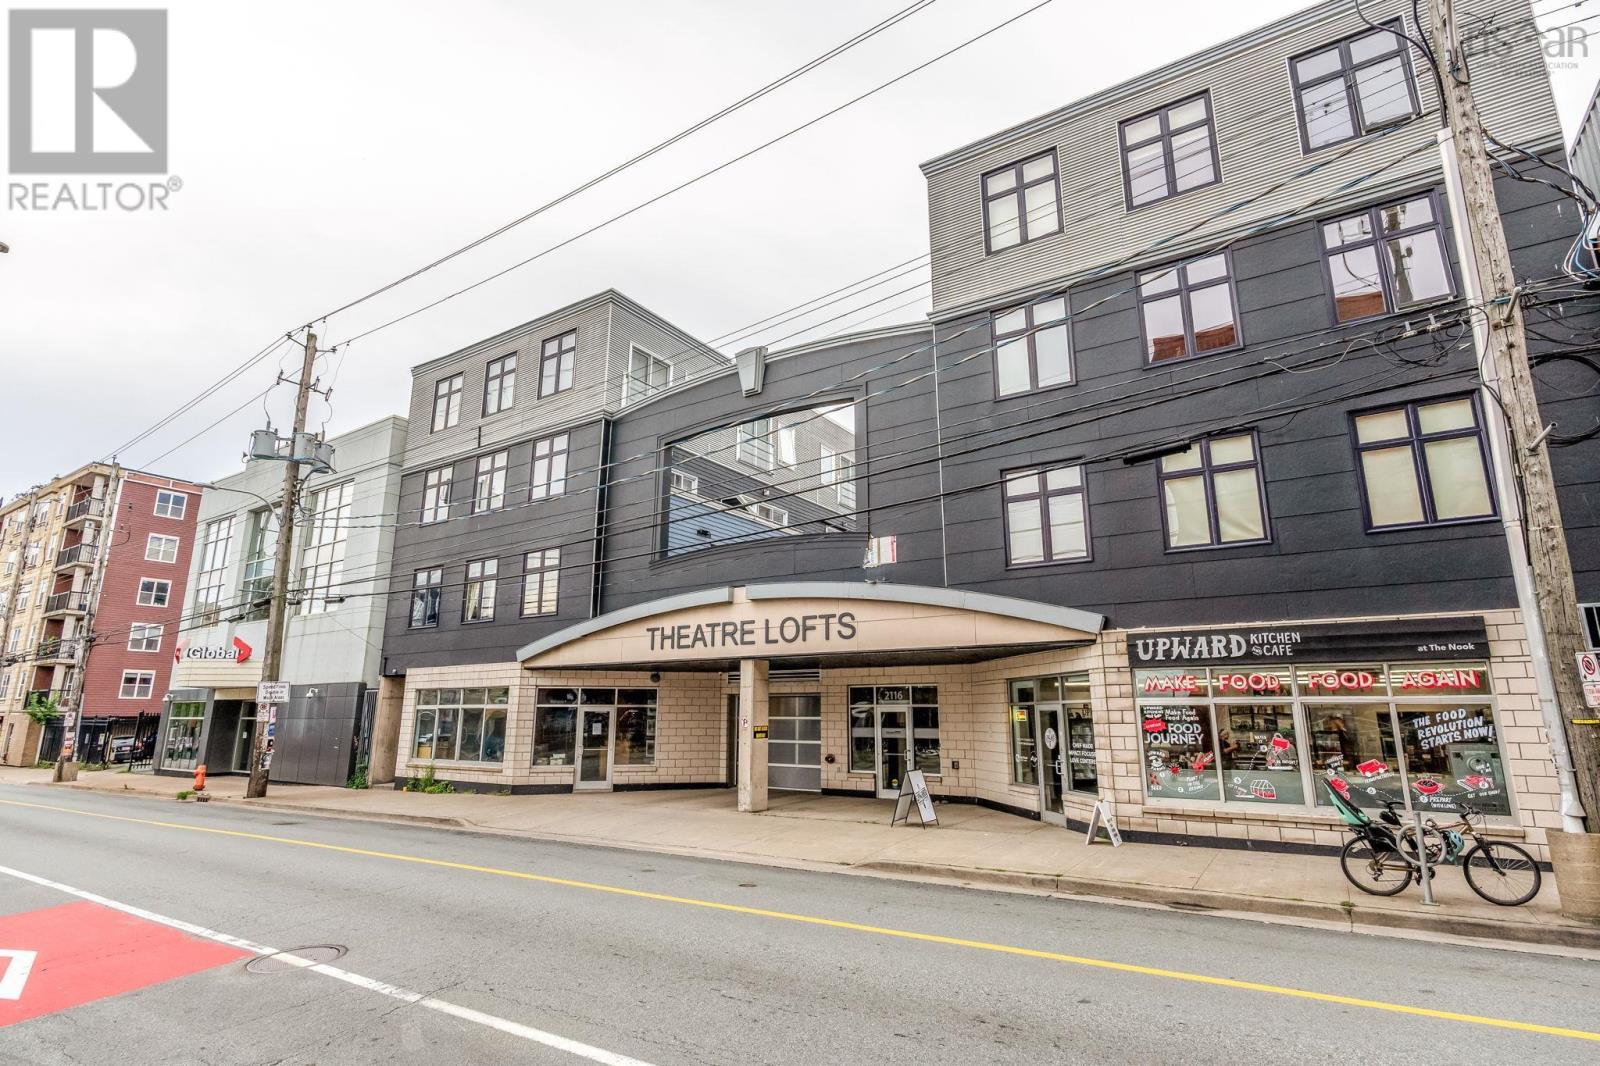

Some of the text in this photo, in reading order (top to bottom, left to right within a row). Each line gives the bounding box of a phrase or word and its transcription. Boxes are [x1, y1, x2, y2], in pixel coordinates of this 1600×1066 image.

[647, 612, 857, 650] THEATRE LOFTS
[1251, 632, 1301, 644] KITCHEN
[1136, 635, 1247, 661] UPWARD
[1264, 645, 1293, 656] CAFE
[1145, 669, 1480, 691] MAKE FOOD FOOD AGAIN
[884, 691, 903, 700] 2116
[1168, 723, 1201, 733] FOOD
[1413, 708, 1467, 728] THE FOOD
[1418, 716, 1483, 740] REVOLUTION
[1144, 733, 1204, 744] JOURNEY
[1421, 725, 1493, 750] STARTS NOW!
